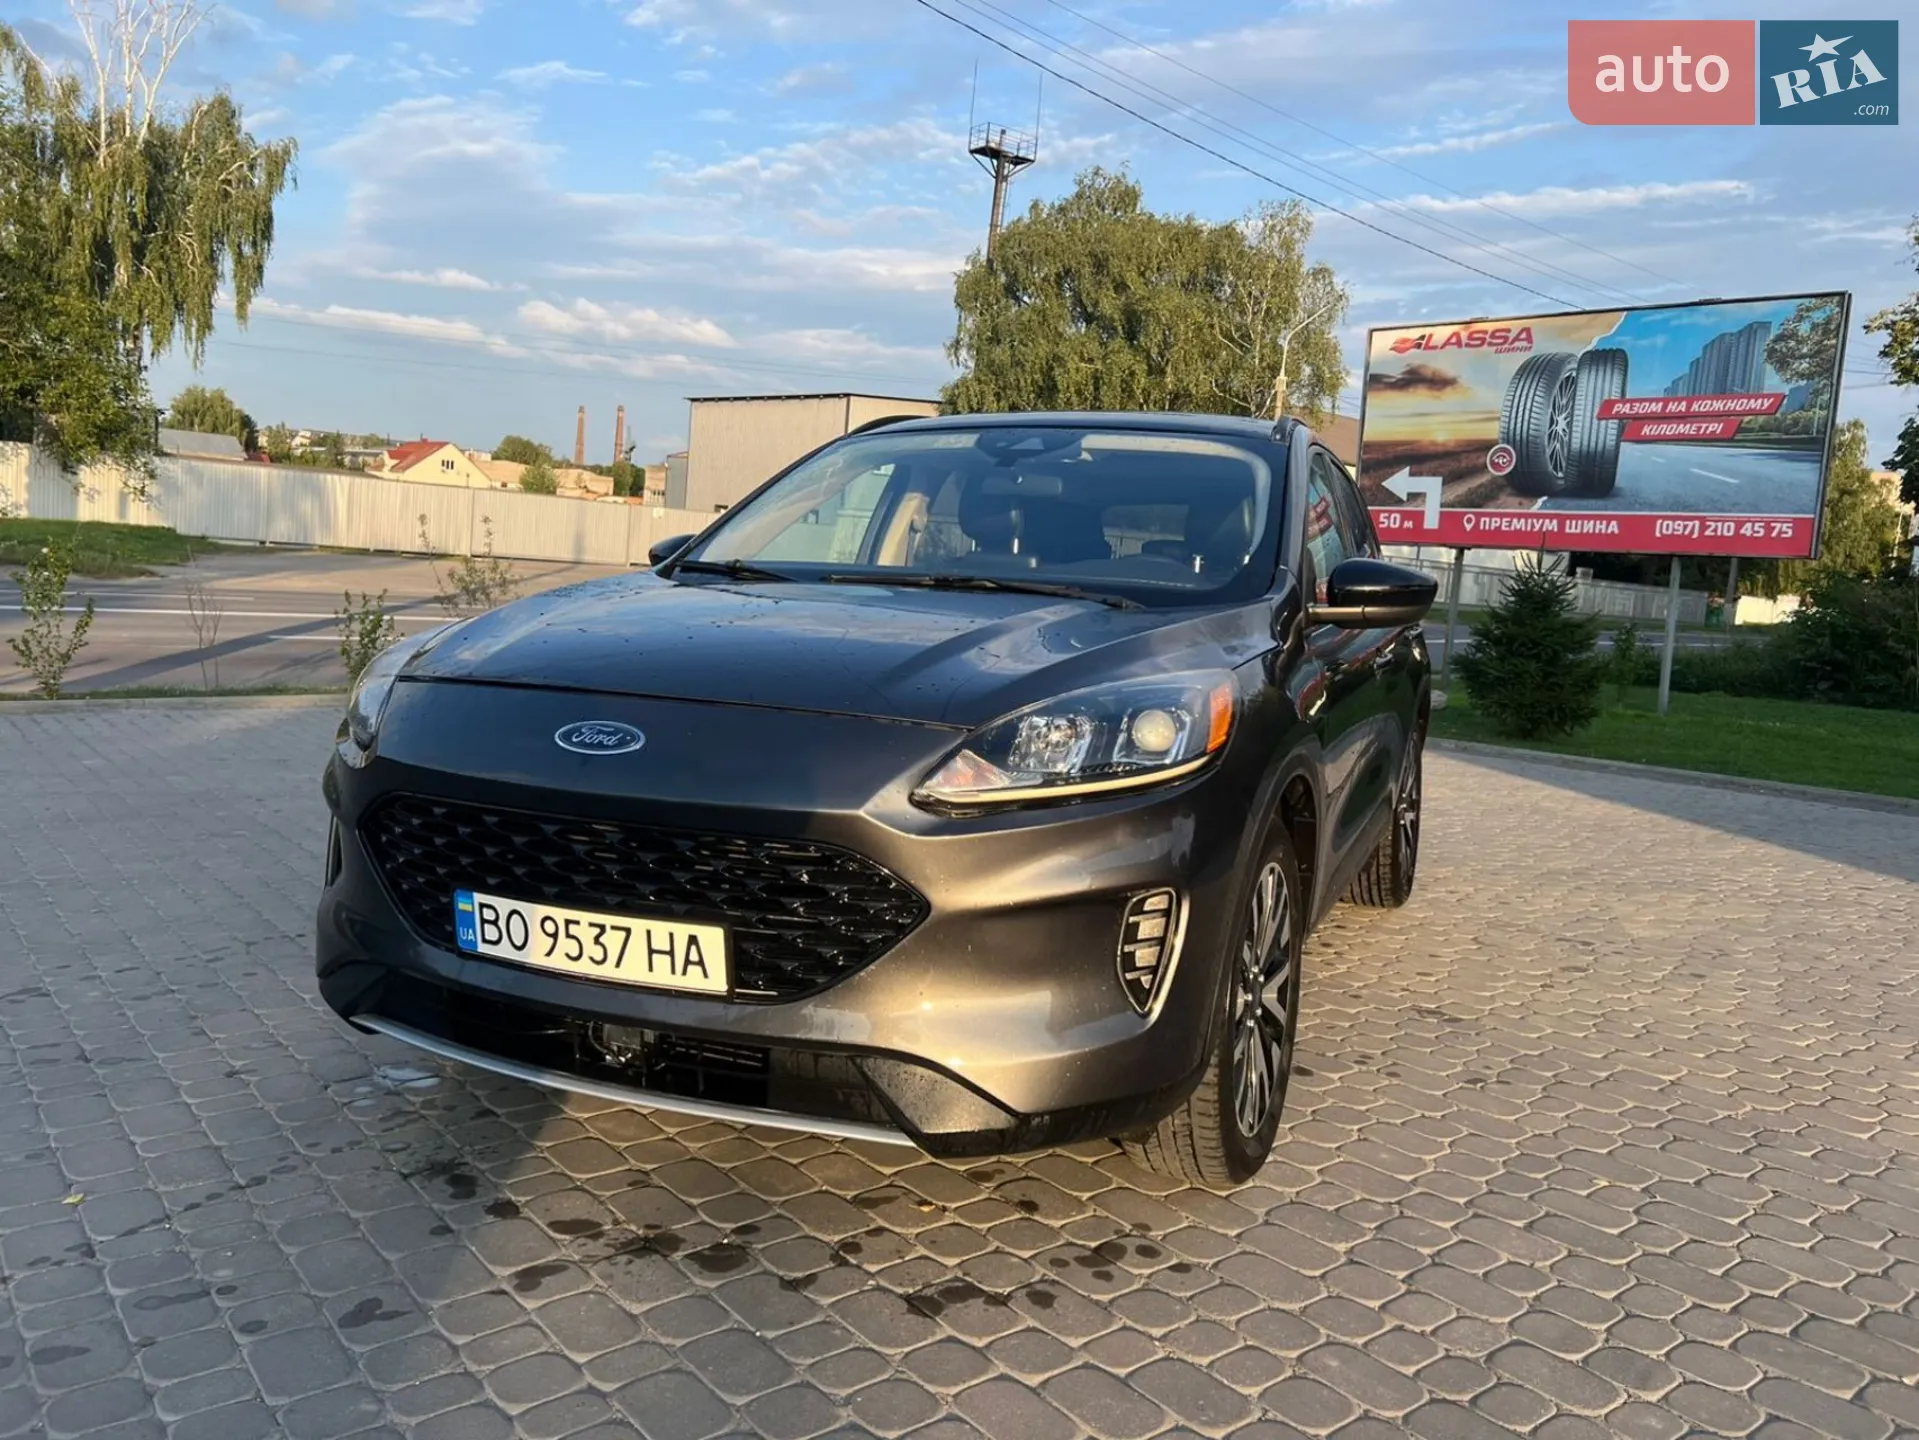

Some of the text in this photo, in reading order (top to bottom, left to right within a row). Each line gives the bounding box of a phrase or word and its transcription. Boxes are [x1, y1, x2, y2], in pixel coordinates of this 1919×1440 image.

[1422, 326, 1534, 351] LASSA
[1612, 397, 1774, 415] РАЗОМ НА КОЖНОМУ
[1640, 422, 1723, 436] КІЛОМЕТРІ
[1379, 512, 1400, 529] 50
[1479, 517, 1620, 534] ПРЕМІУМ ШИНА
[1655, 519, 1793, 539] (097) 210 45 75
[572, 725, 624, 746] Ford
[459, 927, 475, 941] UA
[478, 901, 709, 979] BO 9537 HA
